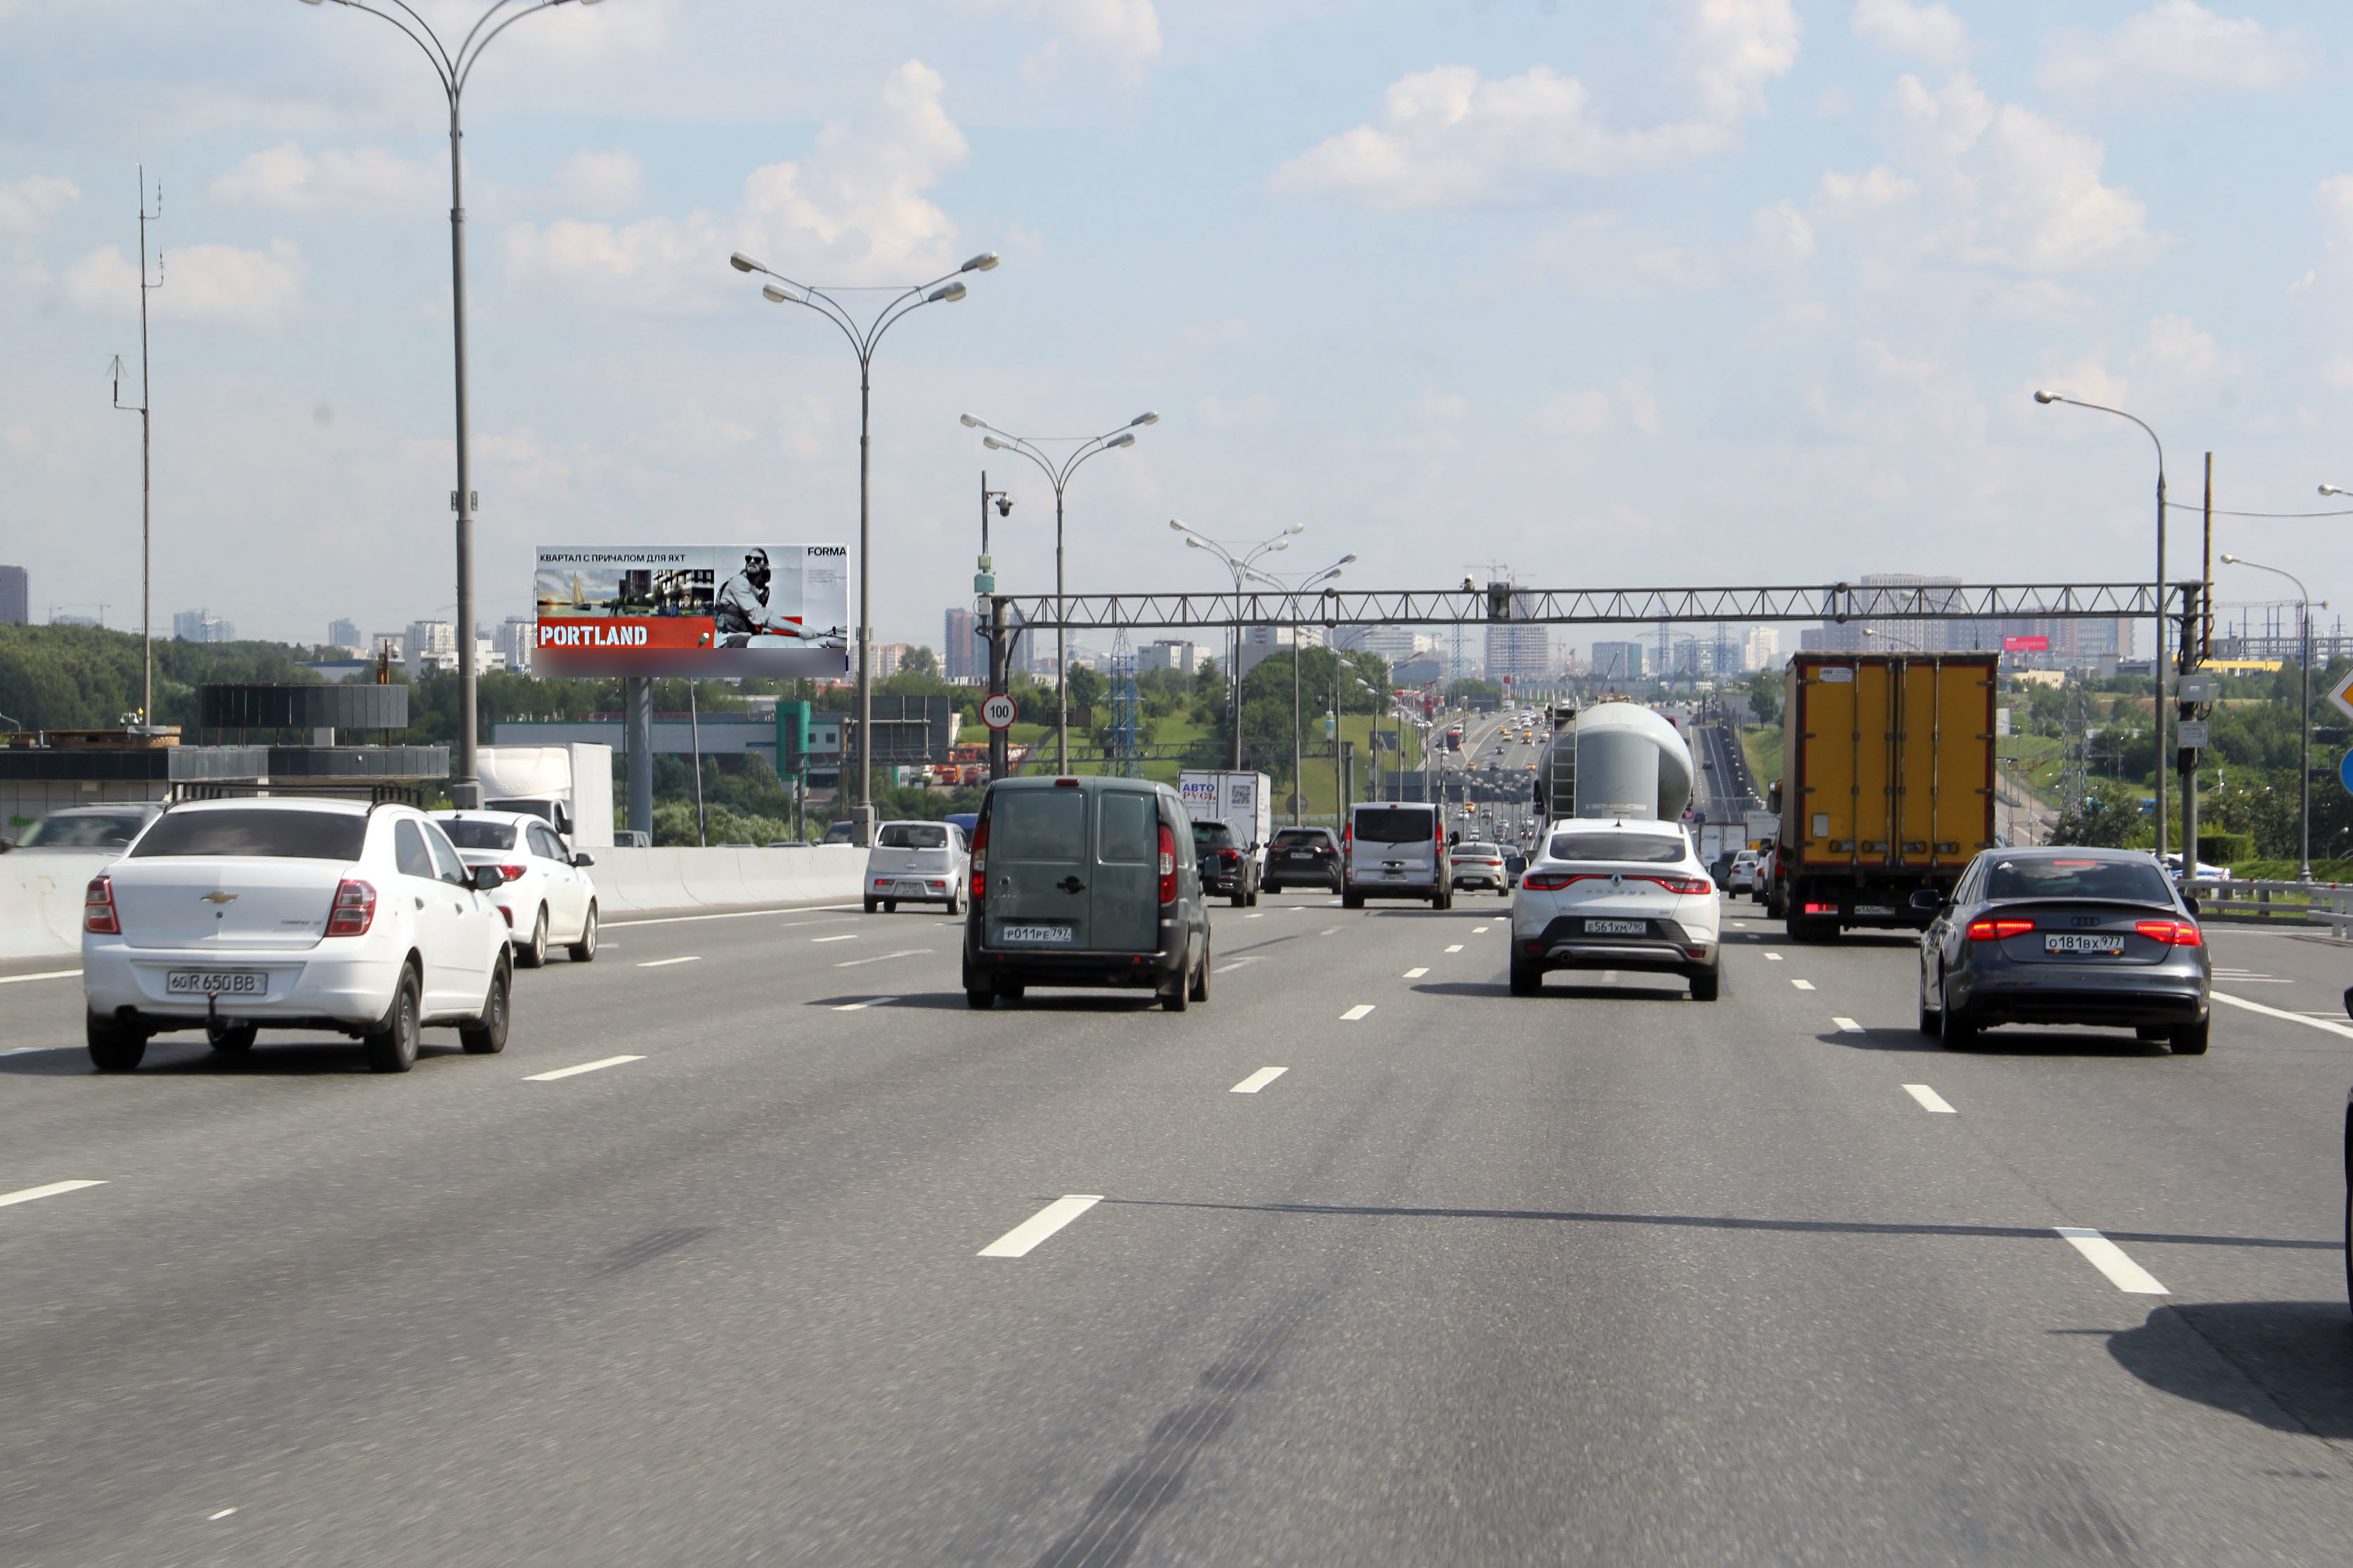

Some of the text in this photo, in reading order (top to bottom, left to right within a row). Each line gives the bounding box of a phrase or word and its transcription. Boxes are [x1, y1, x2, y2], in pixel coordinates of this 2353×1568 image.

[807, 547, 846, 556] FORMA
[540, 554, 686, 563] КВАРТАЛ С ПРИЧАЛОМ ДЛЯ ЯХТ
[541, 626, 647, 645] PORTLAND
[990, 705, 1009, 718] 100
[1182, 784, 1215, 792] АВТО
[1182, 792, 1216, 801] РУСЬ
